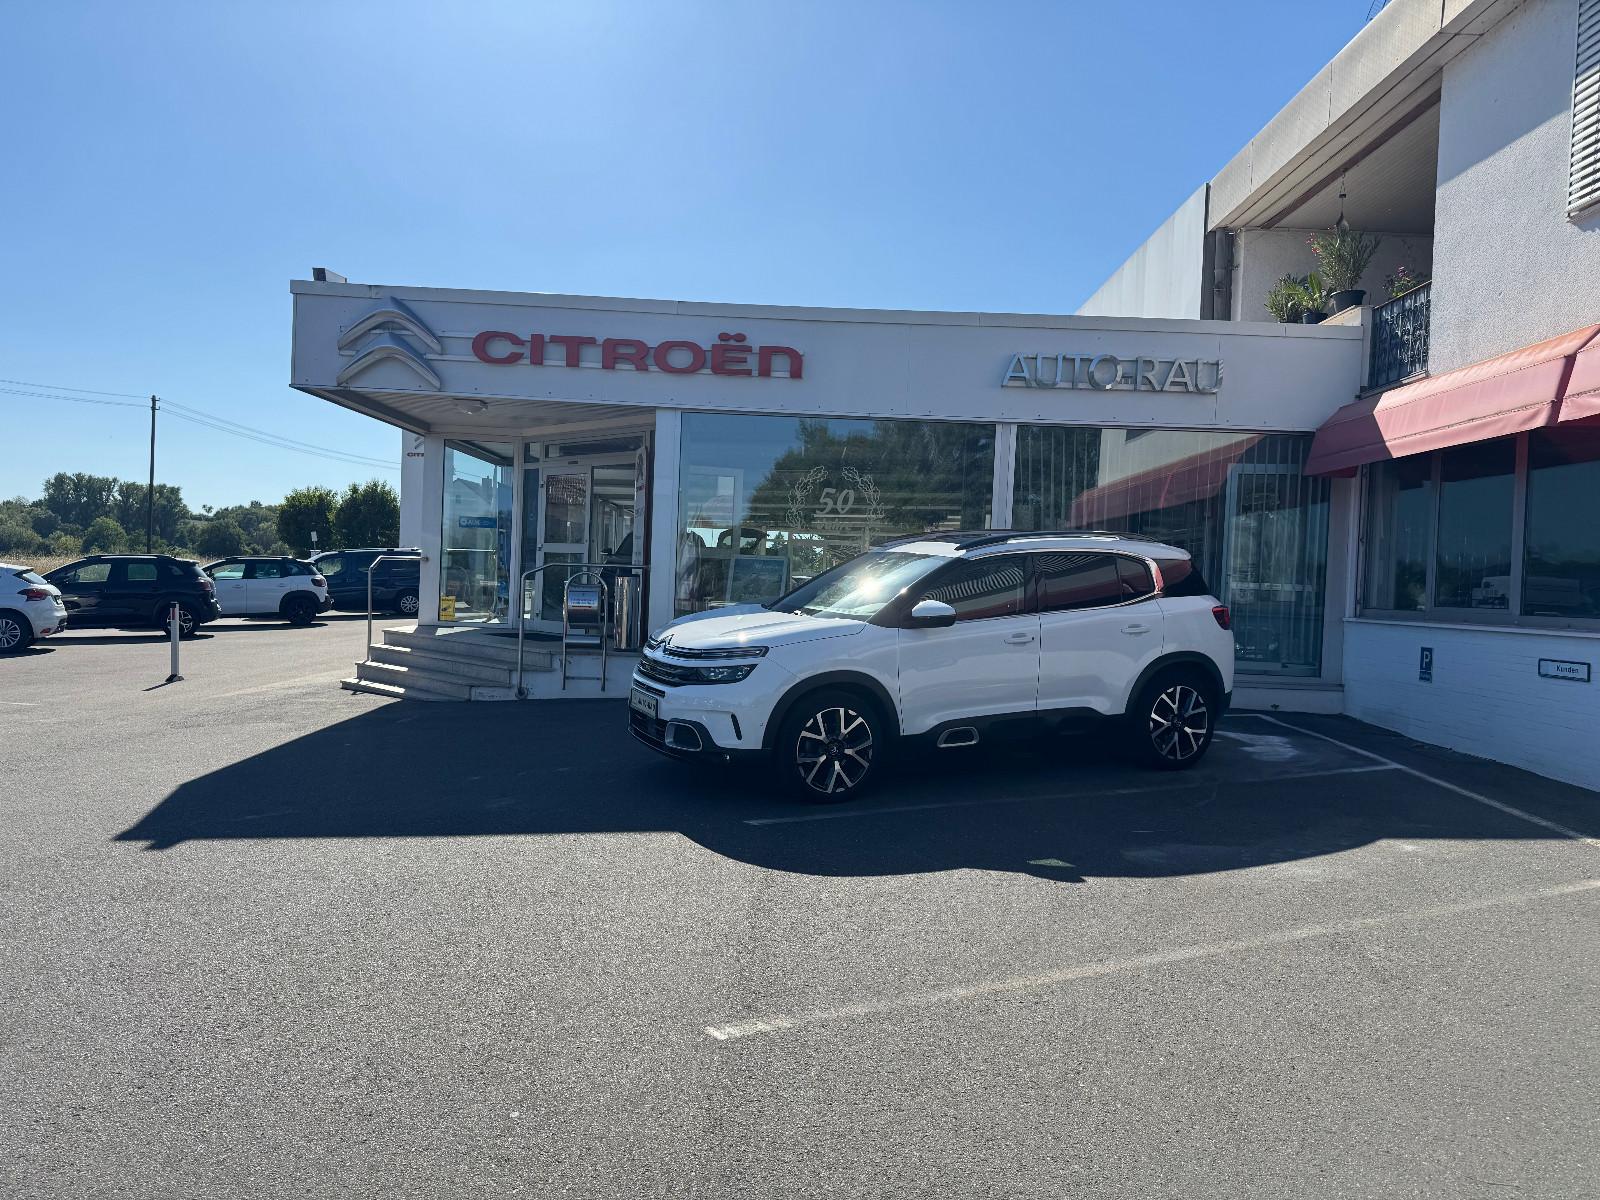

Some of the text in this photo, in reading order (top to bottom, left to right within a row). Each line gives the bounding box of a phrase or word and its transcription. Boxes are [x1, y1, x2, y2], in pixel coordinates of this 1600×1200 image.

[816, 488, 855, 513] 50
[1423, 651, 1431, 668] P
[1556, 665, 1579, 673] Kunden
